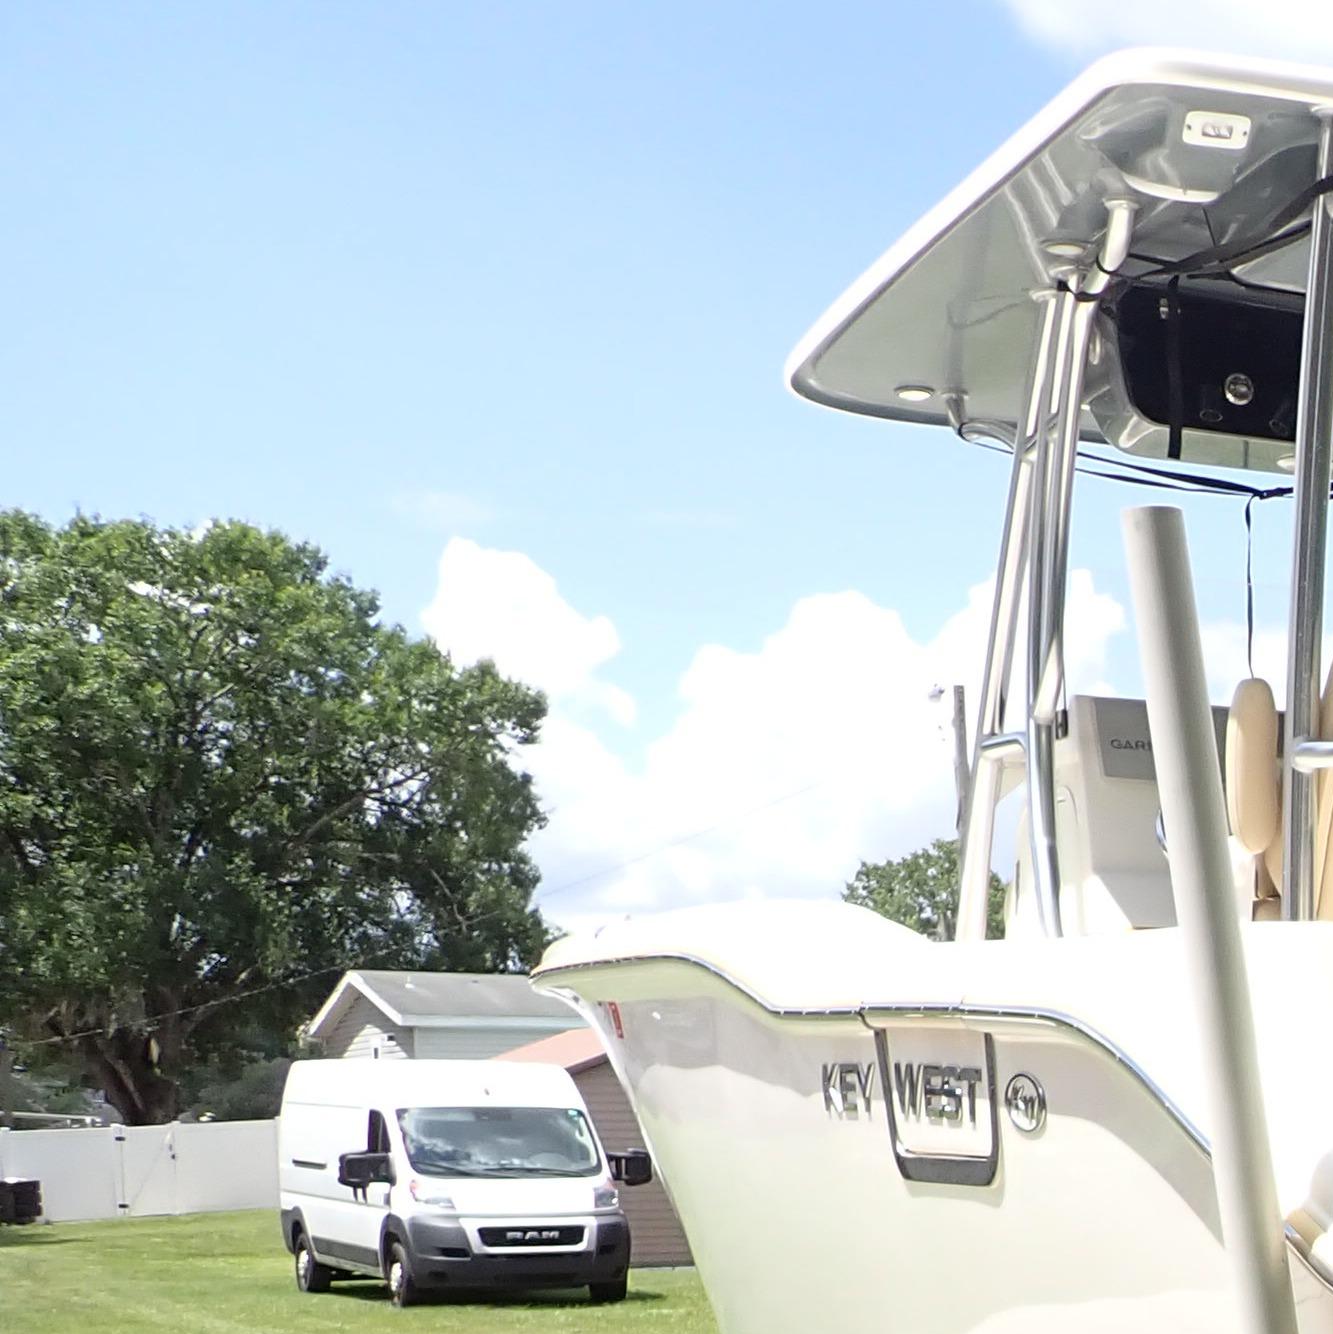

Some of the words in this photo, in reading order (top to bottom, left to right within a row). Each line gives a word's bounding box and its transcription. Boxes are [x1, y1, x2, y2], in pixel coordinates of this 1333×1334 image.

[822, 1062, 875, 1118] KEY
[894, 1062, 982, 1123] WEST
[506, 1230, 560, 1241] RAM
